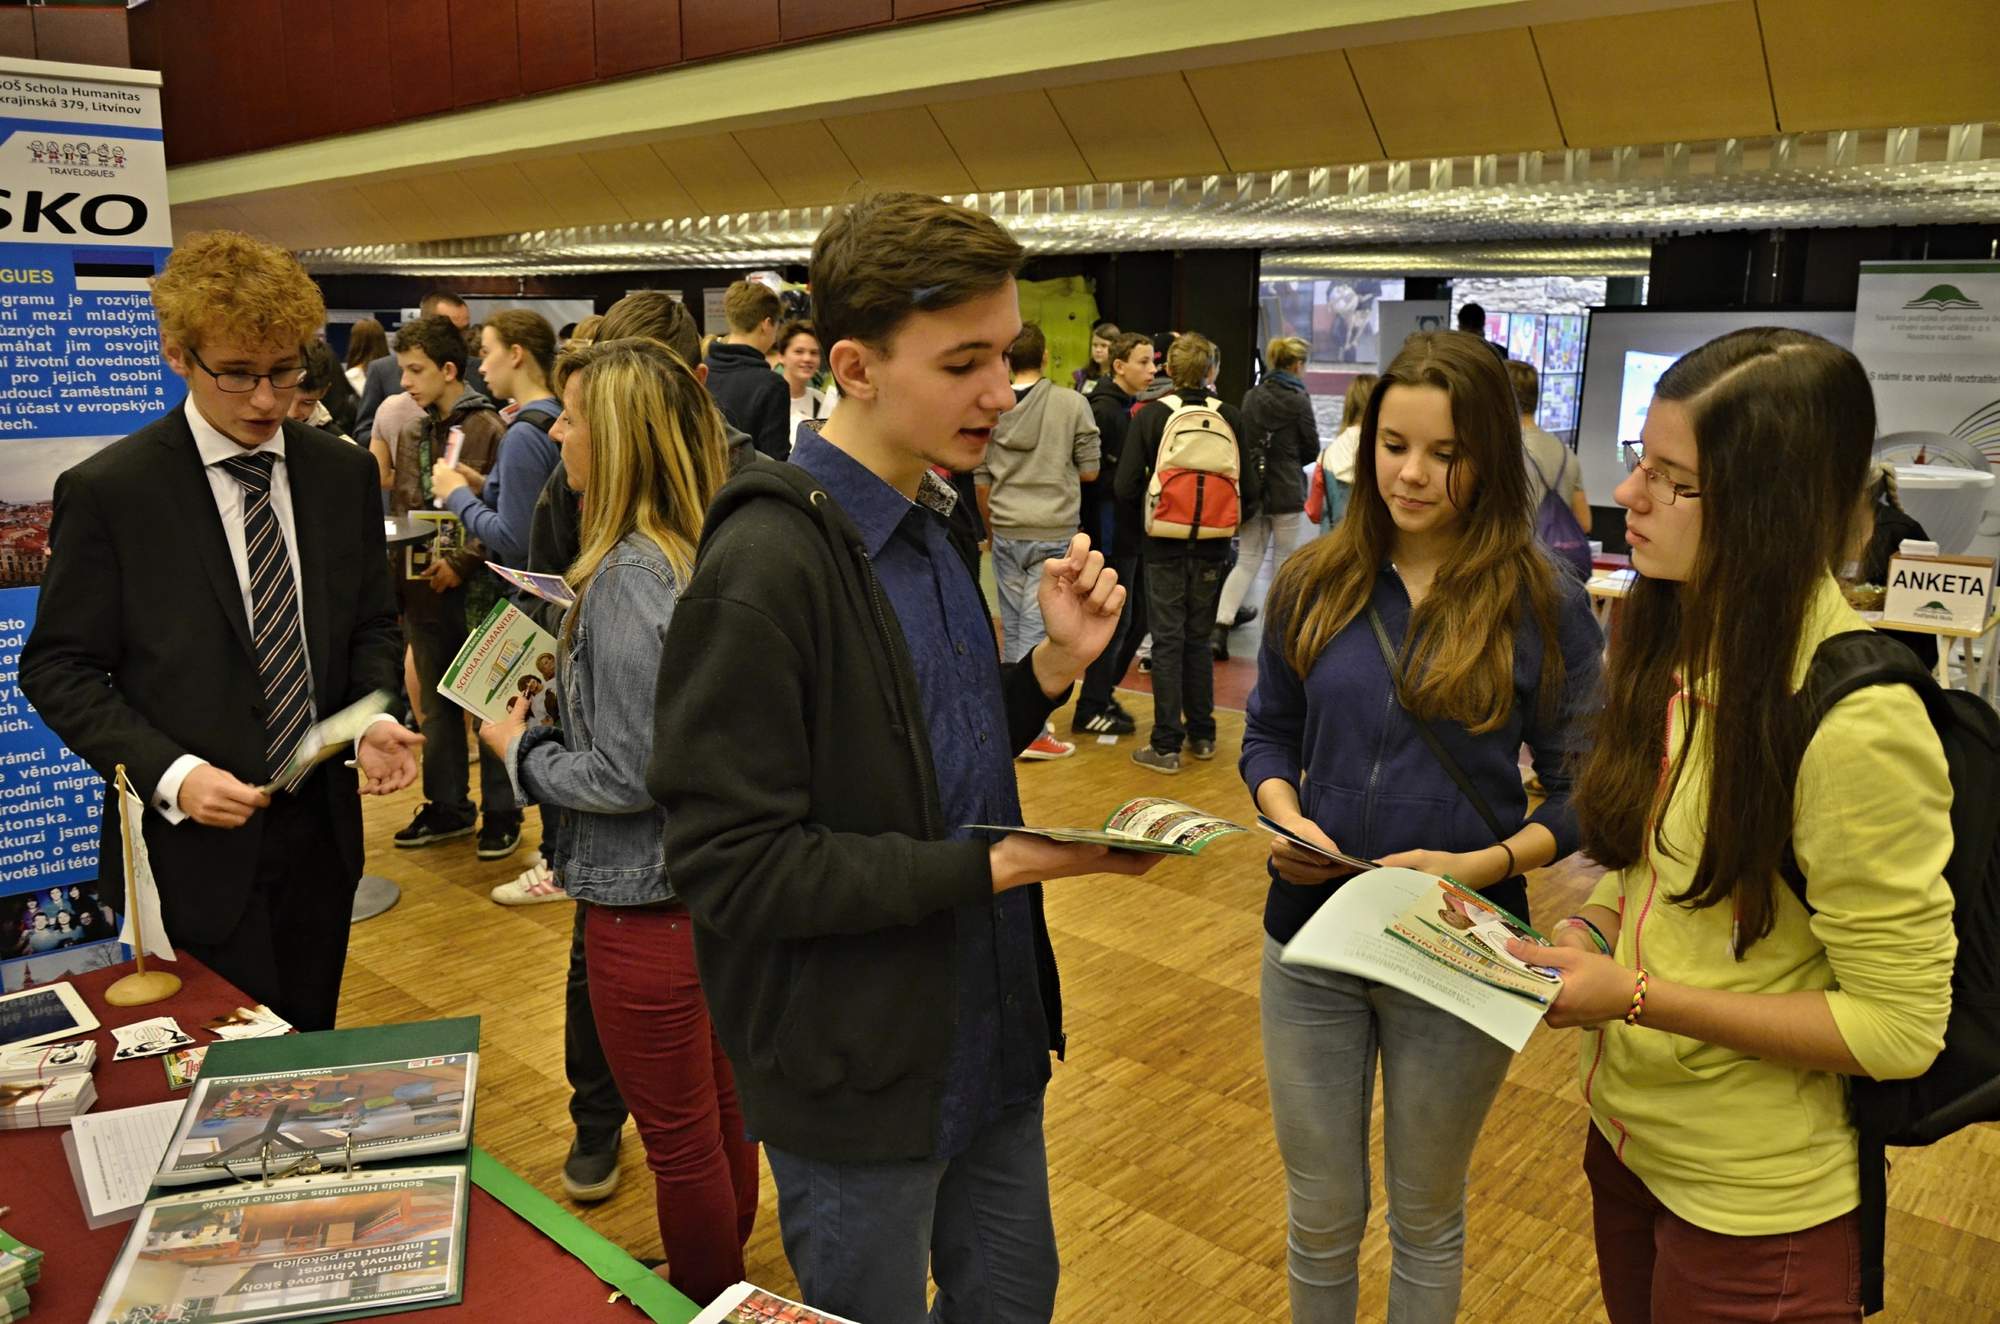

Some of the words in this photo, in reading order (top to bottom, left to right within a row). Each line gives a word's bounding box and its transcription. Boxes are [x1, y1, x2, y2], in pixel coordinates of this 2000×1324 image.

[25, 82, 68, 95] Schola
[72, 87, 140, 102] Humanitas
[61, 99, 89, 111] 379,
[92, 102, 141, 114] Litvínov
[49, 167, 115, 178] TRAVELOGUES
[0, 268, 54, 284] GUES
[1, 295, 55, 307] gramu
[68, 294, 83, 307] je
[32, 310, 72, 321] mezi
[86, 309, 155, 323] mladými
[68, 324, 157, 338] evropských
[0, 340, 52, 352] máhat
[65, 340, 91, 354] jim
[105, 340, 159, 353] osvojit
[16, 355, 69, 368] životní
[76, 354, 160, 367] dovednosti
[11, 374, 39, 386] pro
[52, 370, 96, 385] jejich
[110, 369, 162, 382] osobní
[1902, 374, 1913, 382] se
[1914, 374, 1926, 382] ve
[60, 385, 148, 398] zaměstnání
[154, 387, 164, 397] a
[16, 402, 60, 414] účast
[64, 403, 73, 412] v
[77, 400, 165, 414] evropských
[1893, 569, 1984, 596] ANKETA
[456, 656, 481, 692] SCHOLA
[479, 607, 518, 657] HUMANITAS
[0, 795, 64, 817] rodních
[74, 794, 84, 804] a
[59, 824, 98, 841] jsme
[52, 847, 63, 856] o
[41, 858, 66, 875] lidí
[67, 856, 98, 870] této
[310, 1184, 379, 1198] Humanitas
[380, 1180, 425, 1192] Schola
[201, 1196, 250, 1211] přírodě
[263, 1190, 300, 1203] škola
[343, 1251, 363, 1260] na
[365, 1241, 425, 1258] internet
[272, 1253, 340, 1270] pokojích
[359, 1250, 424, 1268] zájmová
[296, 1261, 358, 1277] činnost
[348, 1270, 359, 1278] v
[361, 1260, 423, 1278] internát
[238, 1279, 285, 1295] školy
